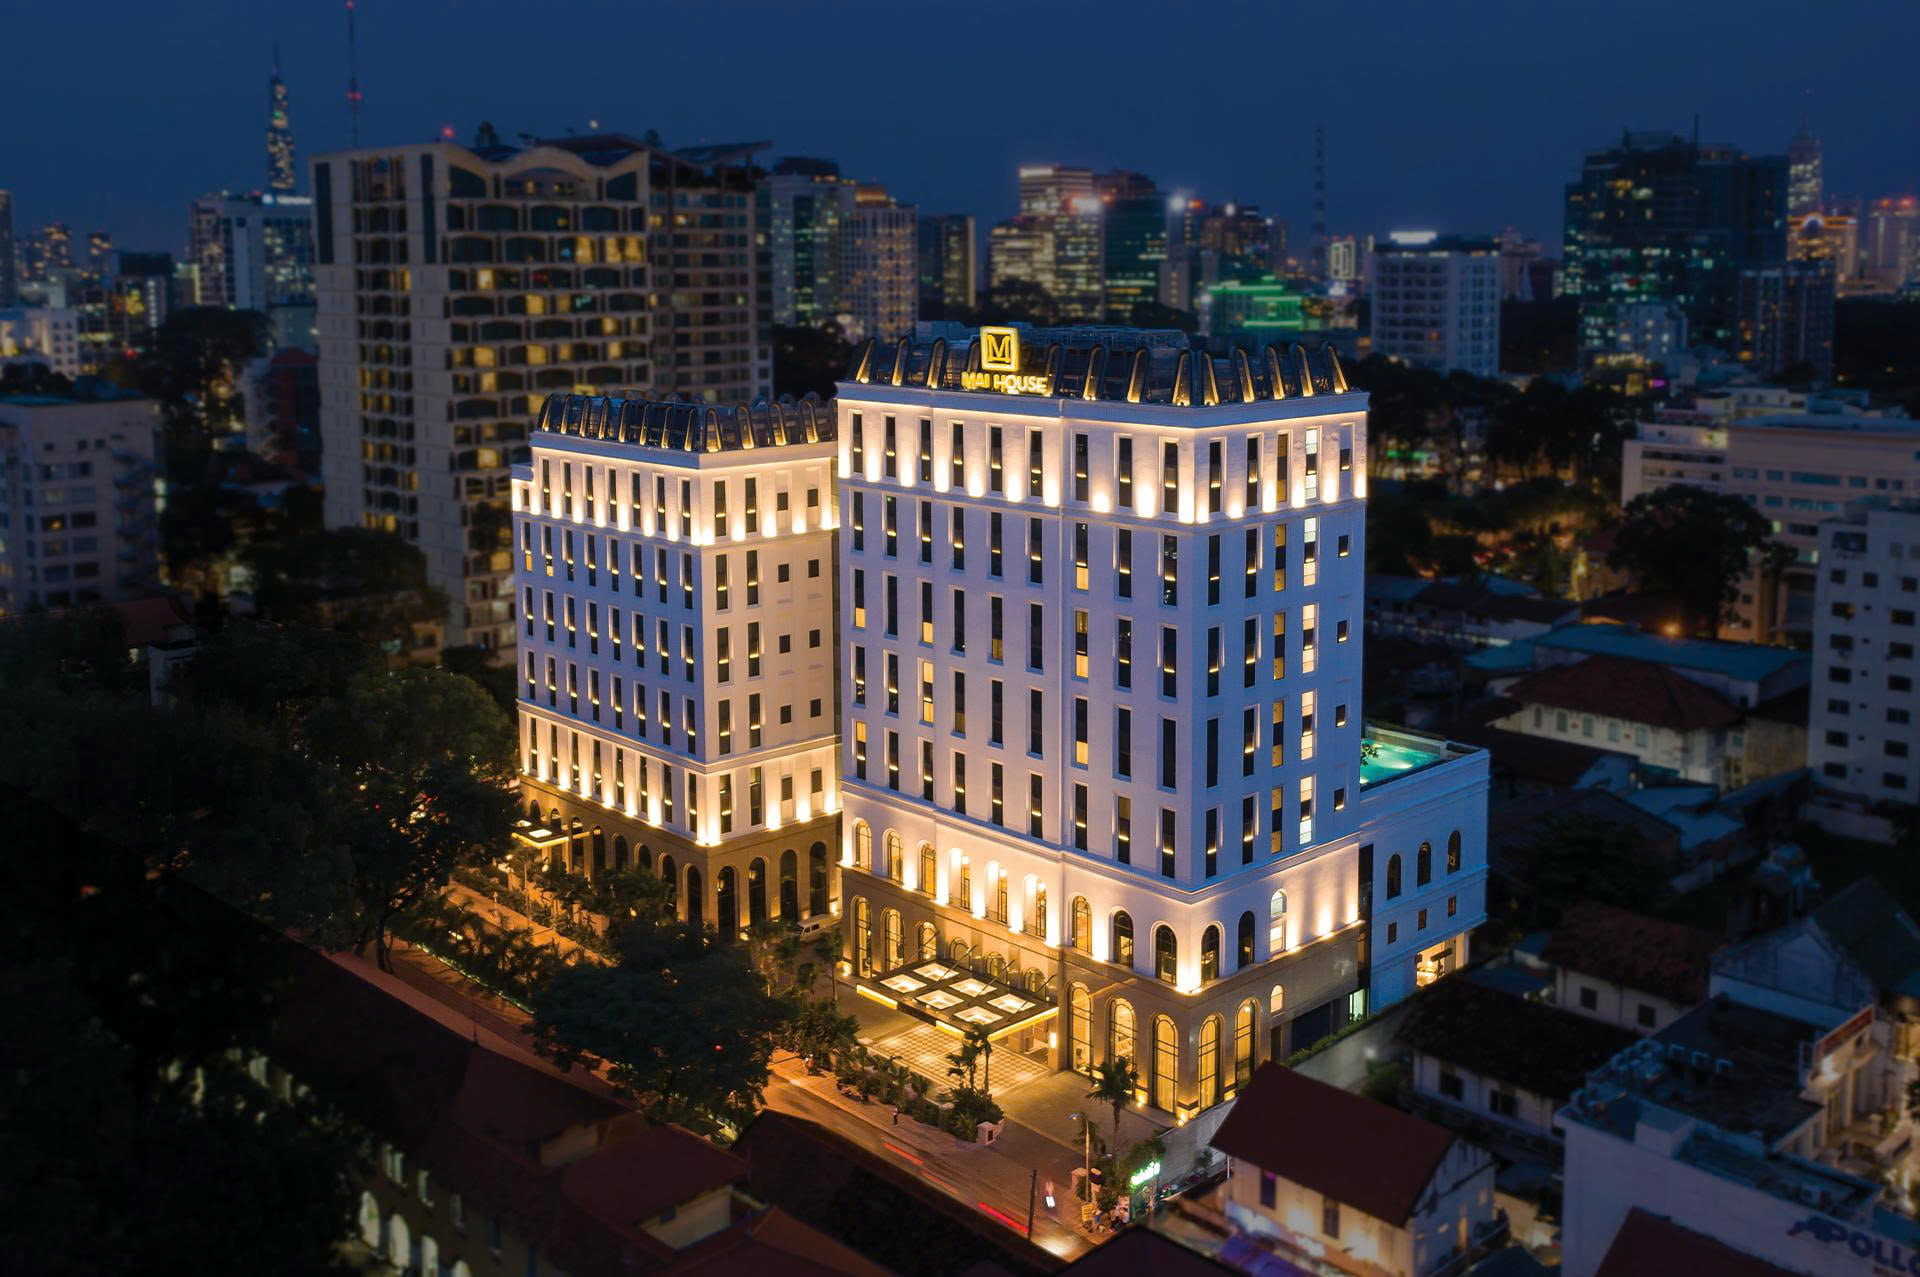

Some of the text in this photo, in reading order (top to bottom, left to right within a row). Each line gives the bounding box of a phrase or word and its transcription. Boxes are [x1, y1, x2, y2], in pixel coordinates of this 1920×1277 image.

[986, 334, 1012, 364] M
[961, 371, 1048, 393] MAI HOUSE
